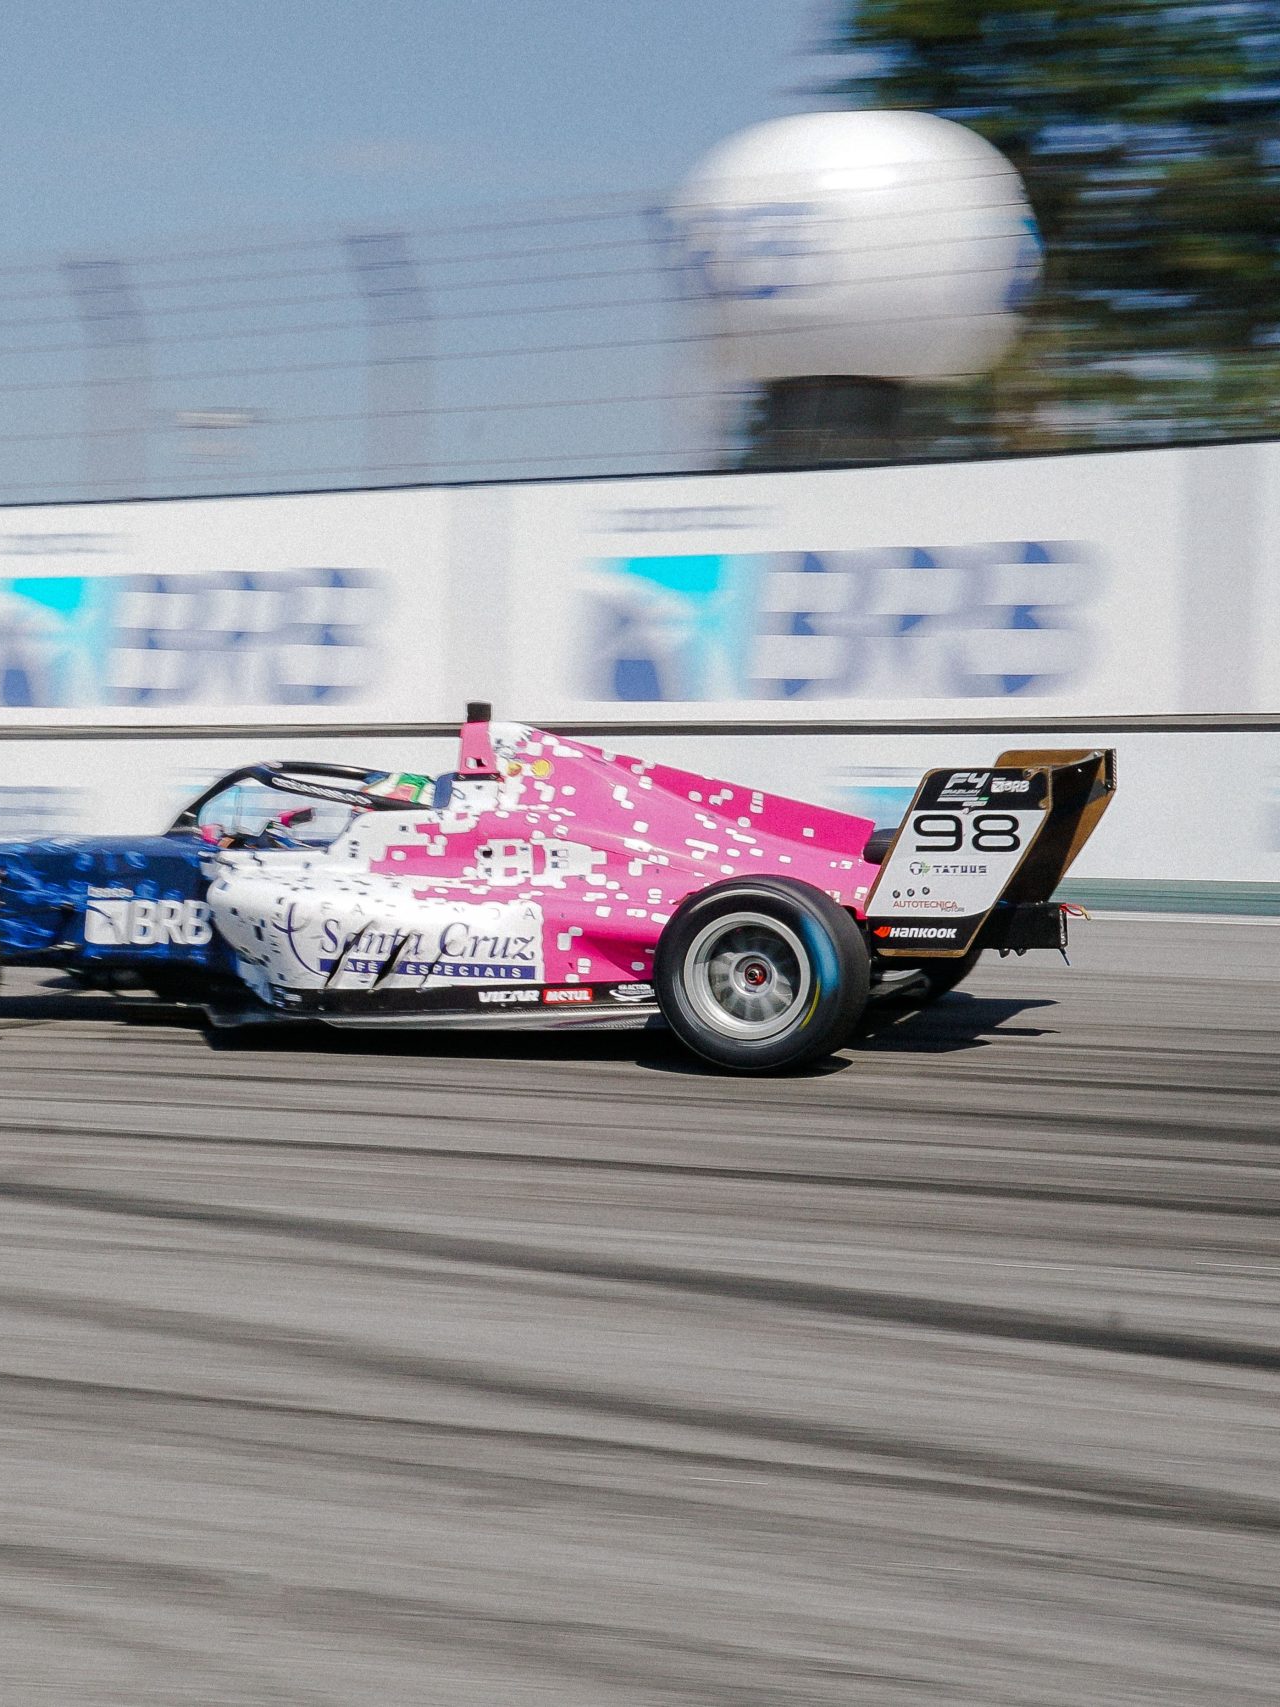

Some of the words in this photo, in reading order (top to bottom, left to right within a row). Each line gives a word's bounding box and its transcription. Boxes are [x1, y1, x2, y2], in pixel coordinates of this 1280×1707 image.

[944, 772, 991, 789] F4
[913, 814, 1021, 853] 98
[932, 865, 988, 874] TATUUS
[892, 900, 958, 910] AUTOTECNICA
[129, 899, 213, 945] BRB
[321, 918, 423, 956] Santa
[439, 921, 535, 961] Cruz
[405, 963, 522, 978] ESPECIAIS
[478, 989, 540, 1003] VICAR
[545, 990, 592, 1002] MOTUL
